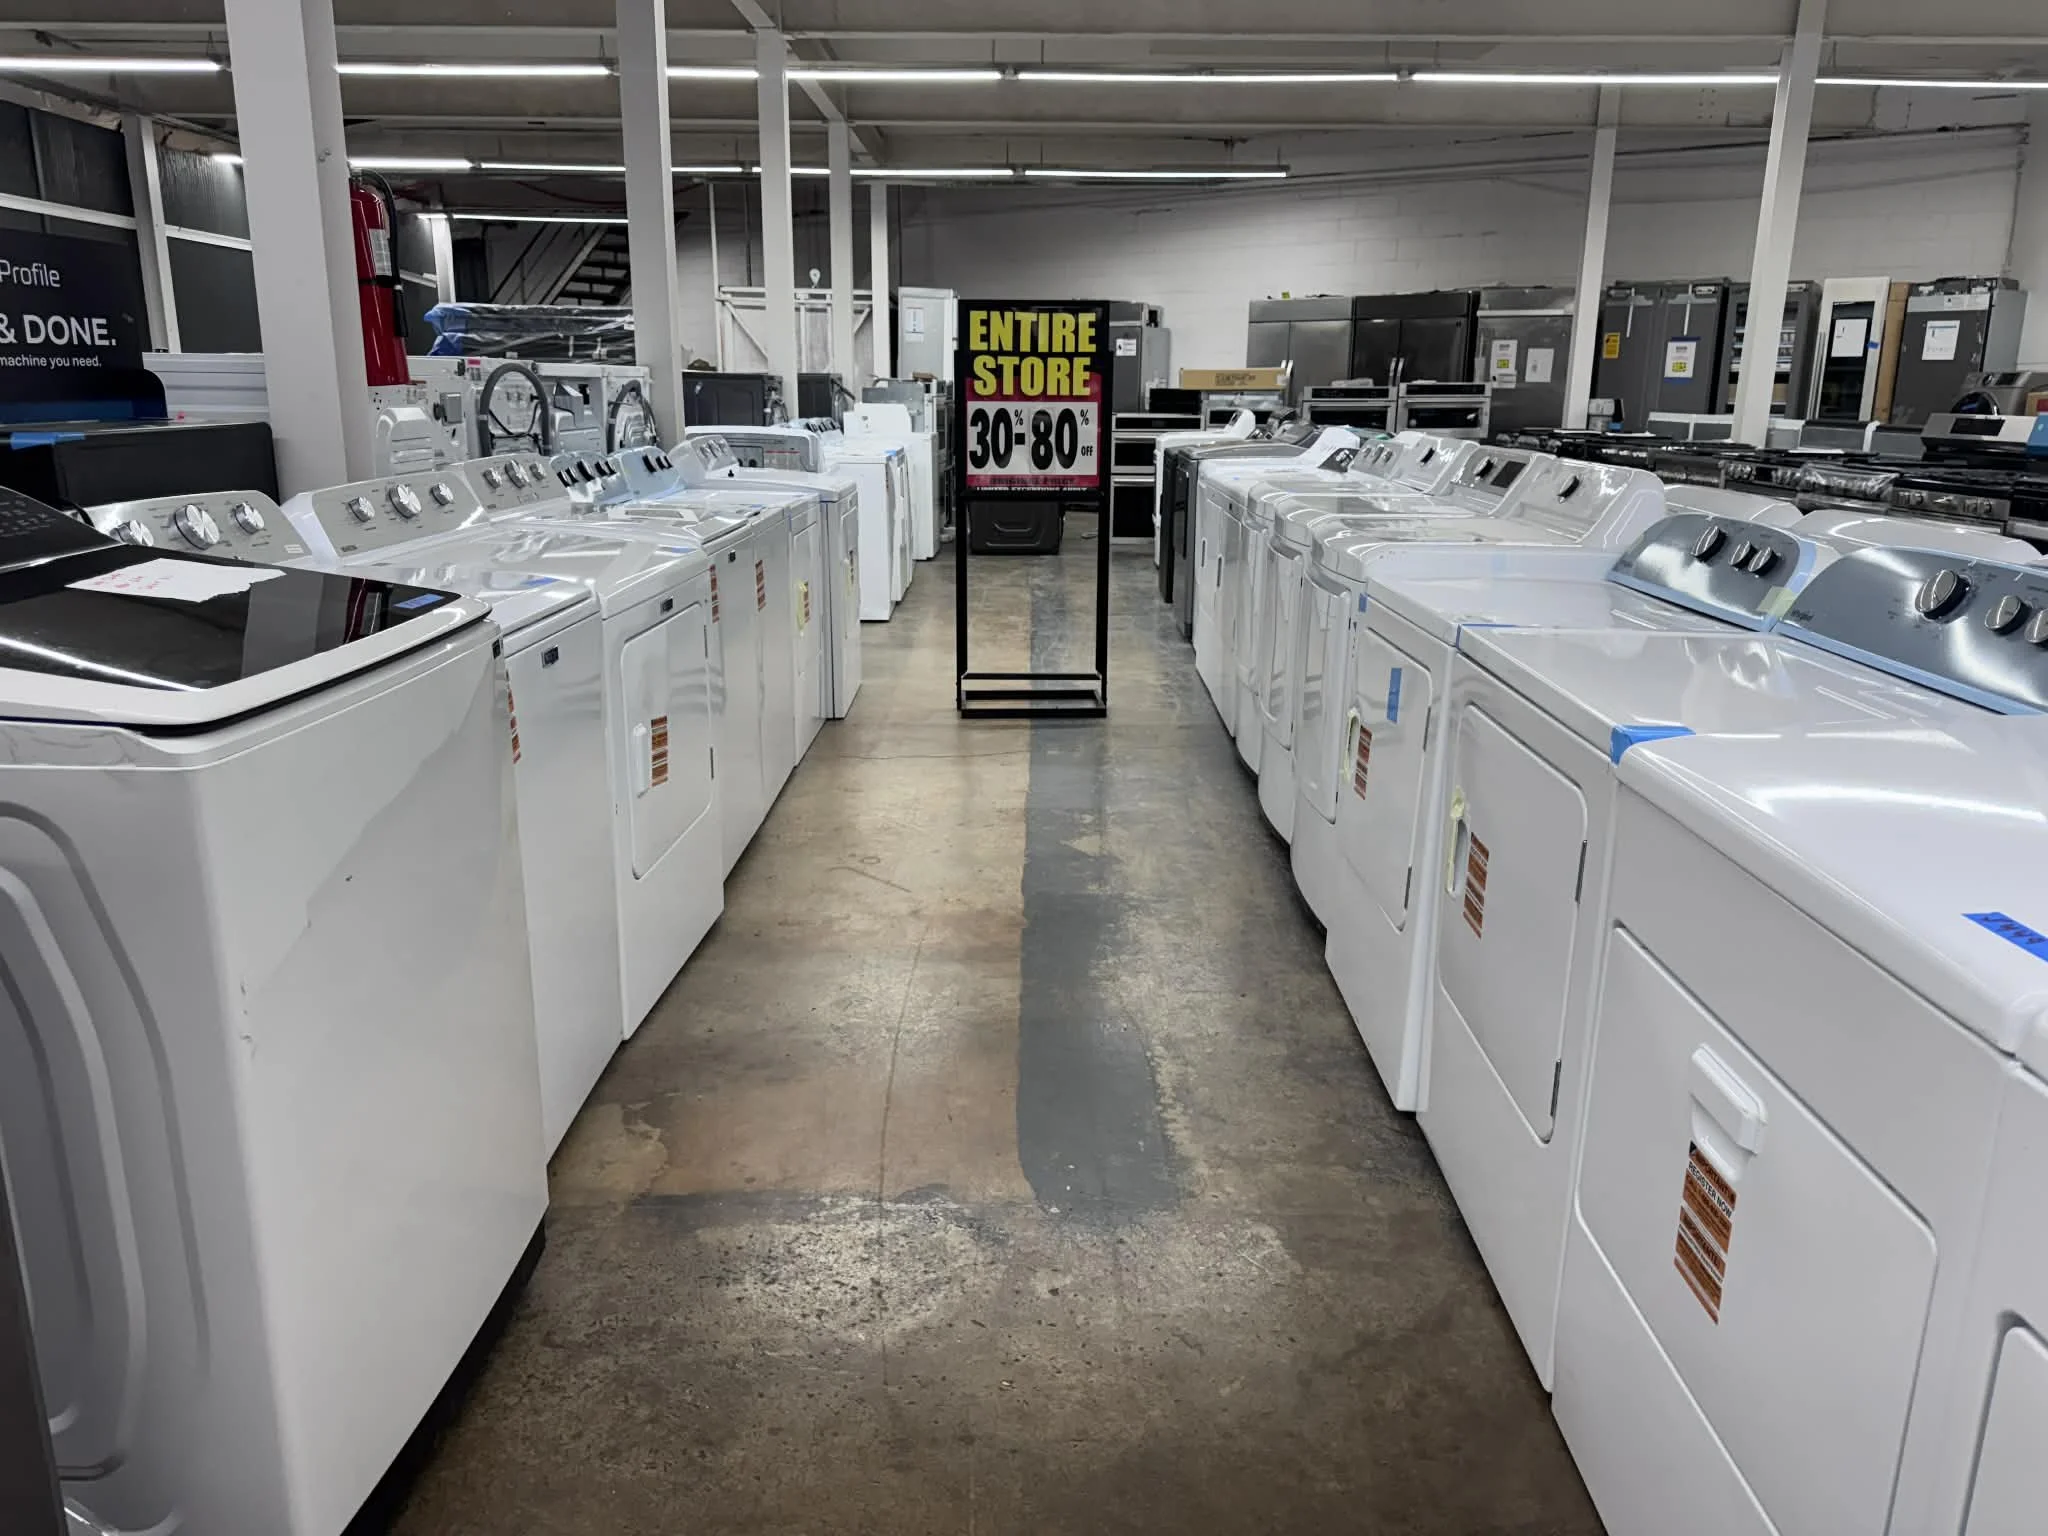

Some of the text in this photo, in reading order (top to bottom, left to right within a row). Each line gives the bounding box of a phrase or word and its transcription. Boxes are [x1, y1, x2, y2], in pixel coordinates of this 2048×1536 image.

[0, 258, 61, 288] Profile
[22, 314, 117, 346] DONE.
[969, 310, 1097, 353] ENTIRE
[48, 356, 71, 370] you
[72, 355, 102, 368] need.
[973, 355, 1091, 396] STORE
[1080, 445, 1093, 457] OFF
[1688, 1160, 1717, 1200] REGISTER
[1716, 1196, 1732, 1218] NOW
